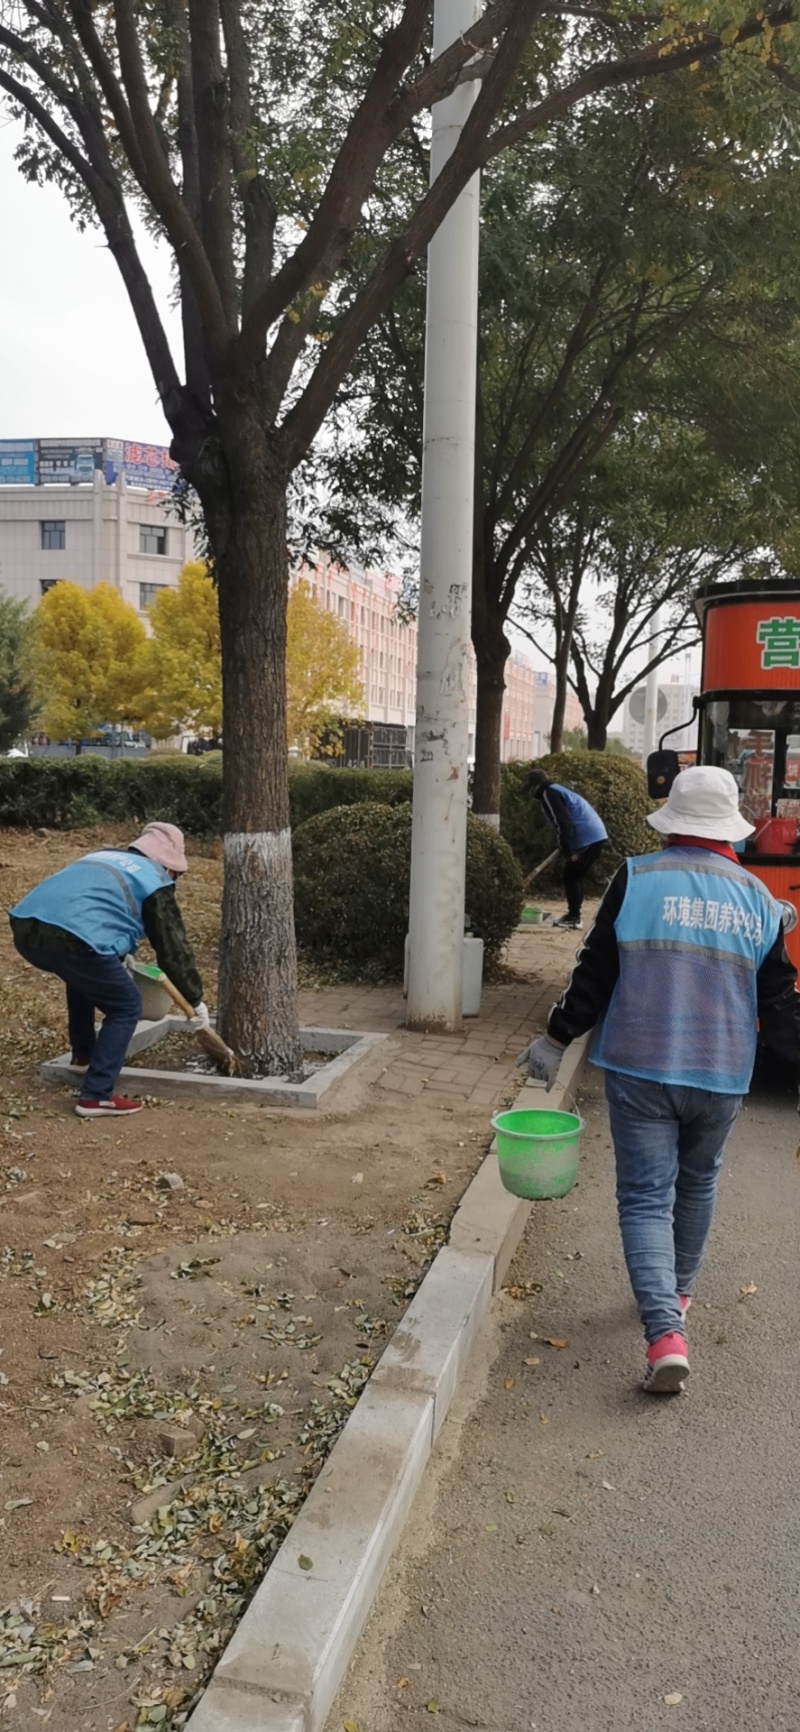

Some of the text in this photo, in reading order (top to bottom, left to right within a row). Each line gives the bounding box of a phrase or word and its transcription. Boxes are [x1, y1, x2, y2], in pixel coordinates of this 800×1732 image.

[757, 616, 800, 669] 营
[663, 895, 764, 947] 环境集团养护公司
